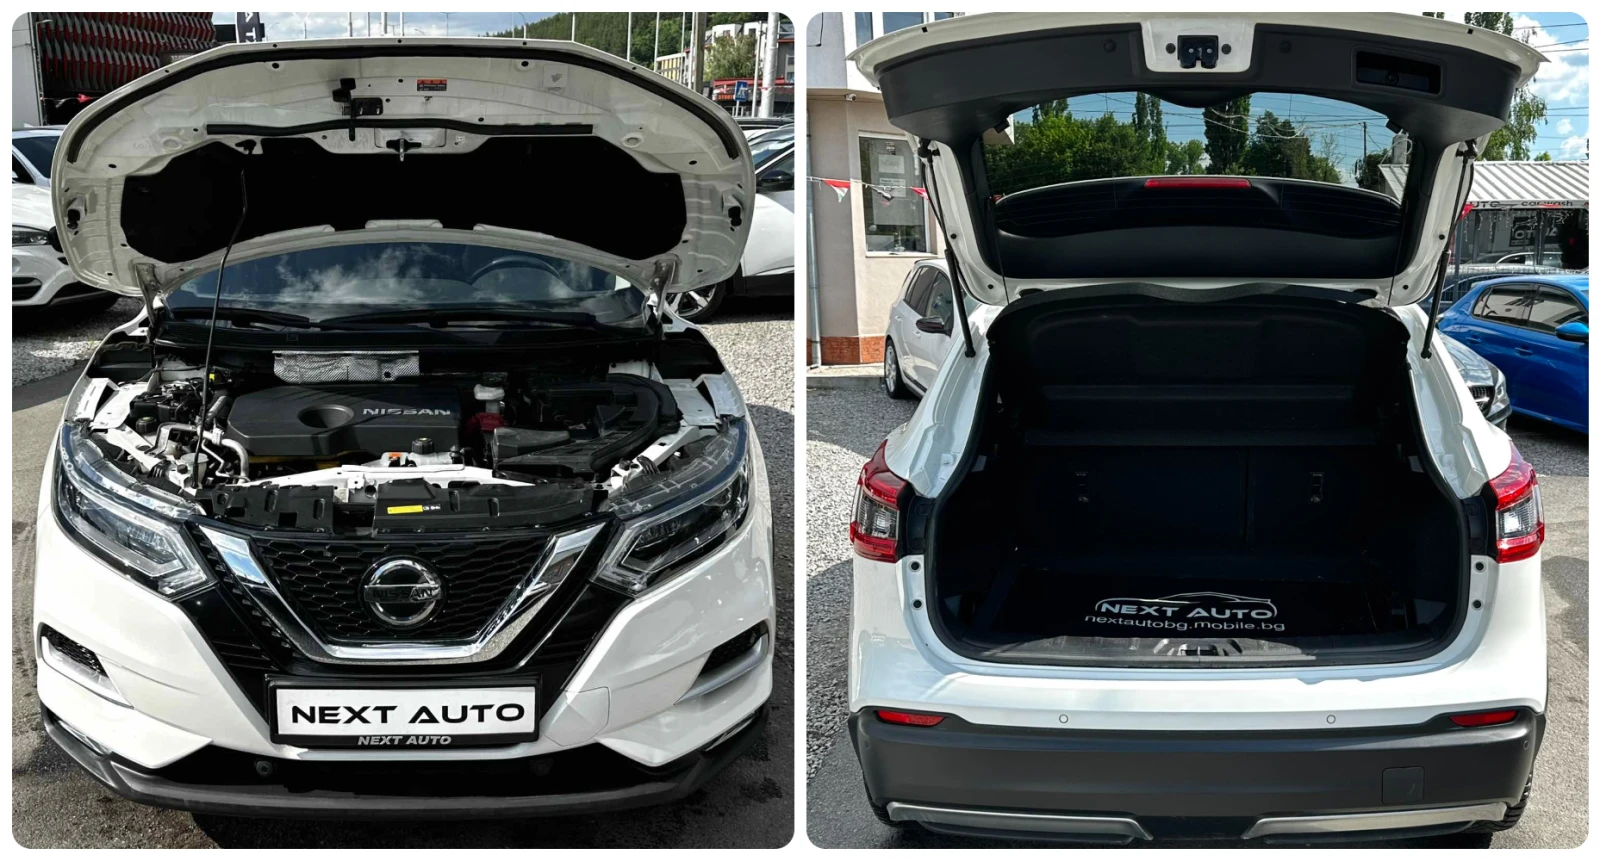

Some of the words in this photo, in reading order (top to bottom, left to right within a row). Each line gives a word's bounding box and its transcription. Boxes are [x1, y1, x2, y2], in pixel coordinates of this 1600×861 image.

[362, 408, 451, 416] NISSAN
[372, 588, 433, 599] NISSAN
[1100, 603, 1180, 617] NEXT
[1186, 607, 1273, 619] AUTO
[1084, 615, 1286, 632] nextautobg.mobile.bg
[291, 705, 398, 724] NEXT
[408, 703, 525, 724] AUTO
[357, 736, 403, 745] NEXT
[405, 735, 452, 745] AUTO
